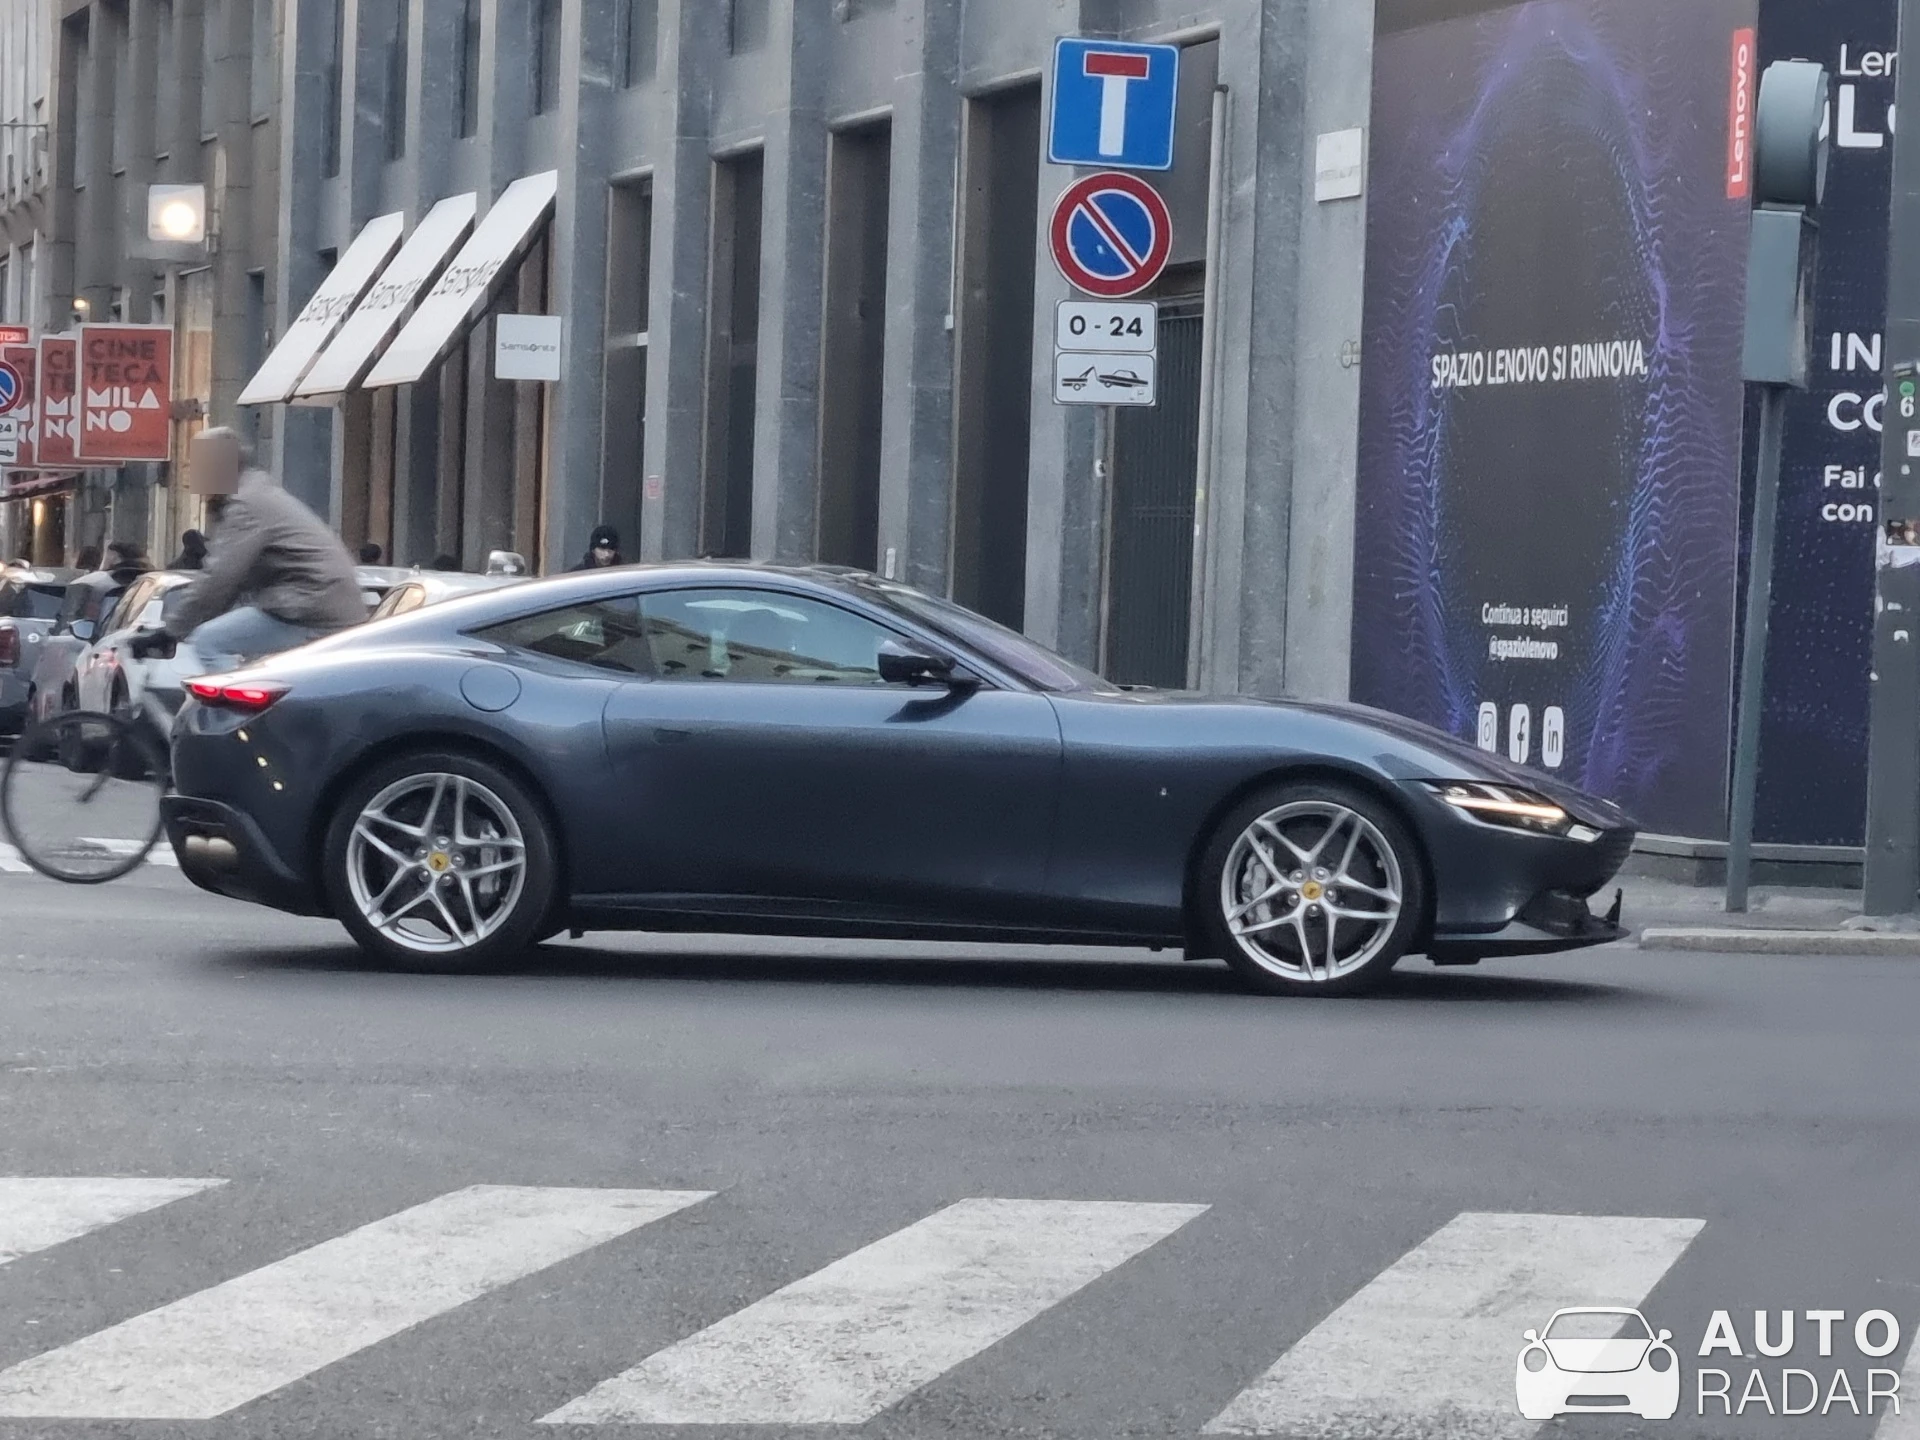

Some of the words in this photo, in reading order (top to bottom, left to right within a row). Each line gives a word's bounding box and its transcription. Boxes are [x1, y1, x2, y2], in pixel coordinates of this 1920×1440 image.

[1731, 43, 1748, 183] Lenovo
[1109, 316, 1143, 338] 24
[89, 337, 157, 360] CINE
[1830, 331, 1881, 372] IN
[86, 362, 162, 384] TECA
[1432, 350, 1484, 389] SPAZIO
[1486, 346, 1549, 385] LENOVO
[1551, 344, 1567, 382] SI
[86, 385, 160, 409] MILA
[86, 409, 132, 433] NO
[1824, 464, 1865, 489] Fai
[1822, 503, 1873, 522] con
[1482, 602, 1521, 625] Continua
[1523, 607, 1530, 626] a
